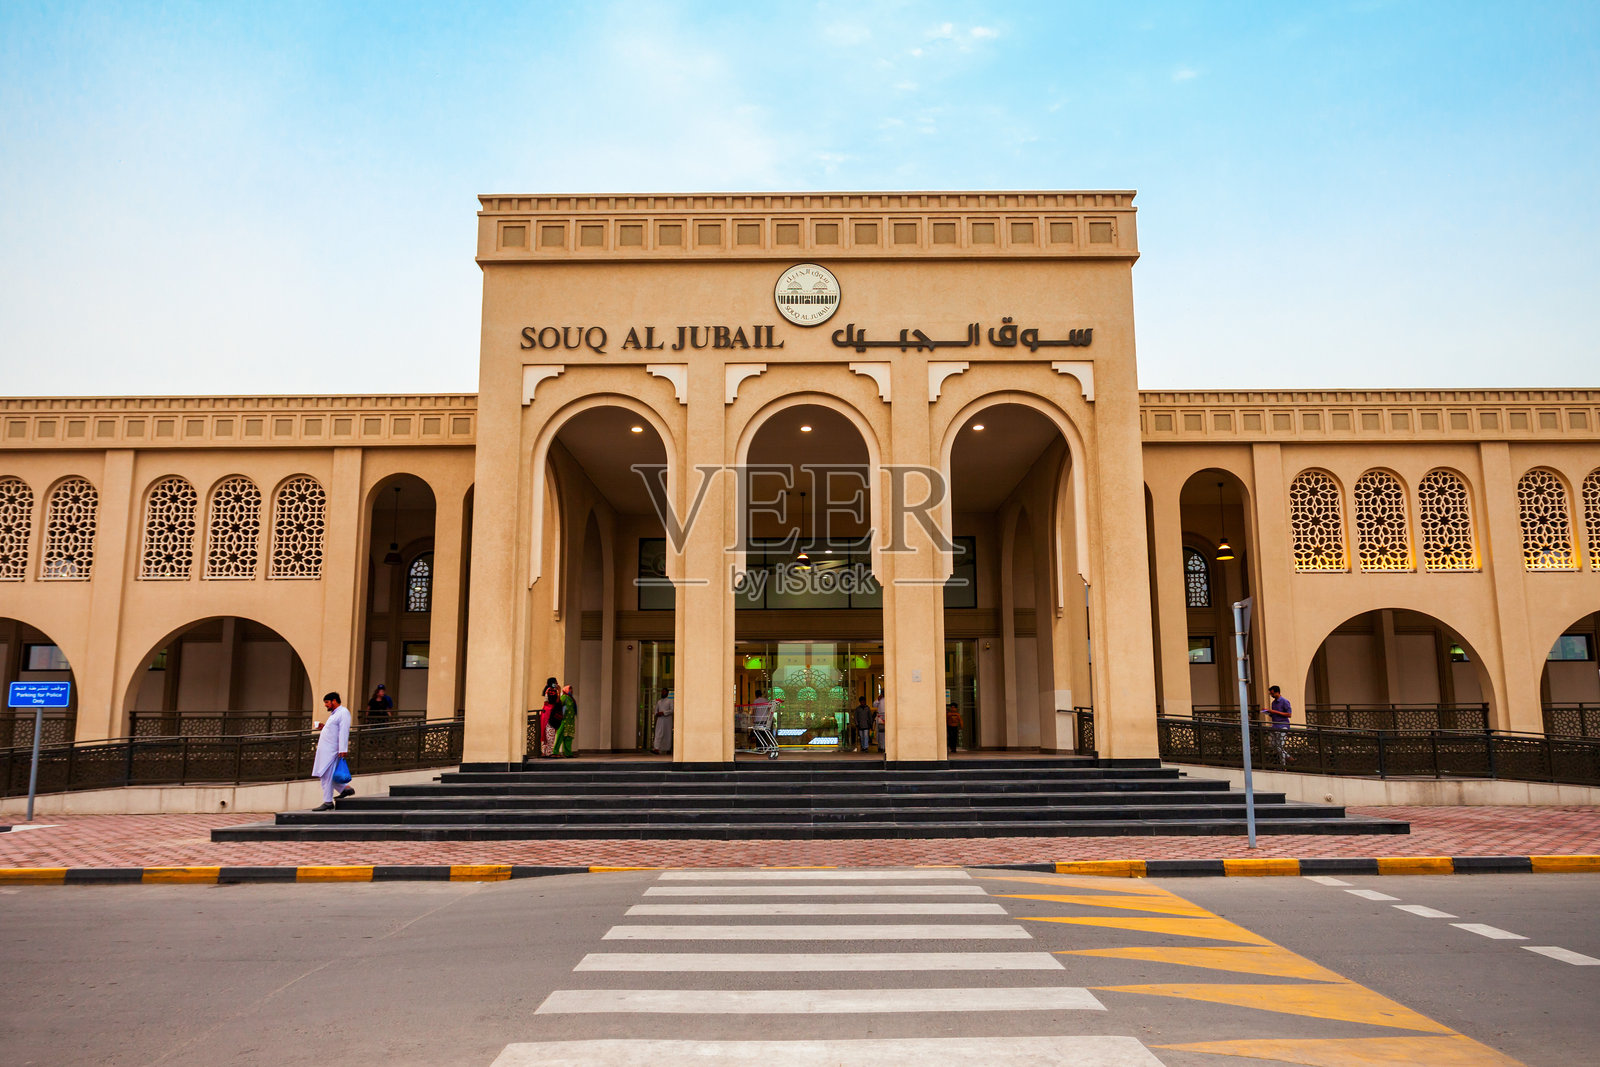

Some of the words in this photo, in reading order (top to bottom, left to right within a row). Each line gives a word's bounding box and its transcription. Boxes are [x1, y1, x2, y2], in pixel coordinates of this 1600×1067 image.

[785, 305, 801, 319] SOUQ
[810, 305, 830, 319] JUBAIL
[520, 326, 608, 354] SOUQ
[621, 326, 664, 350] AL
[672, 325, 785, 351] JUBAIL
[831, 322, 980, 352] الجبيل
[988, 316, 1094, 352] سوق
